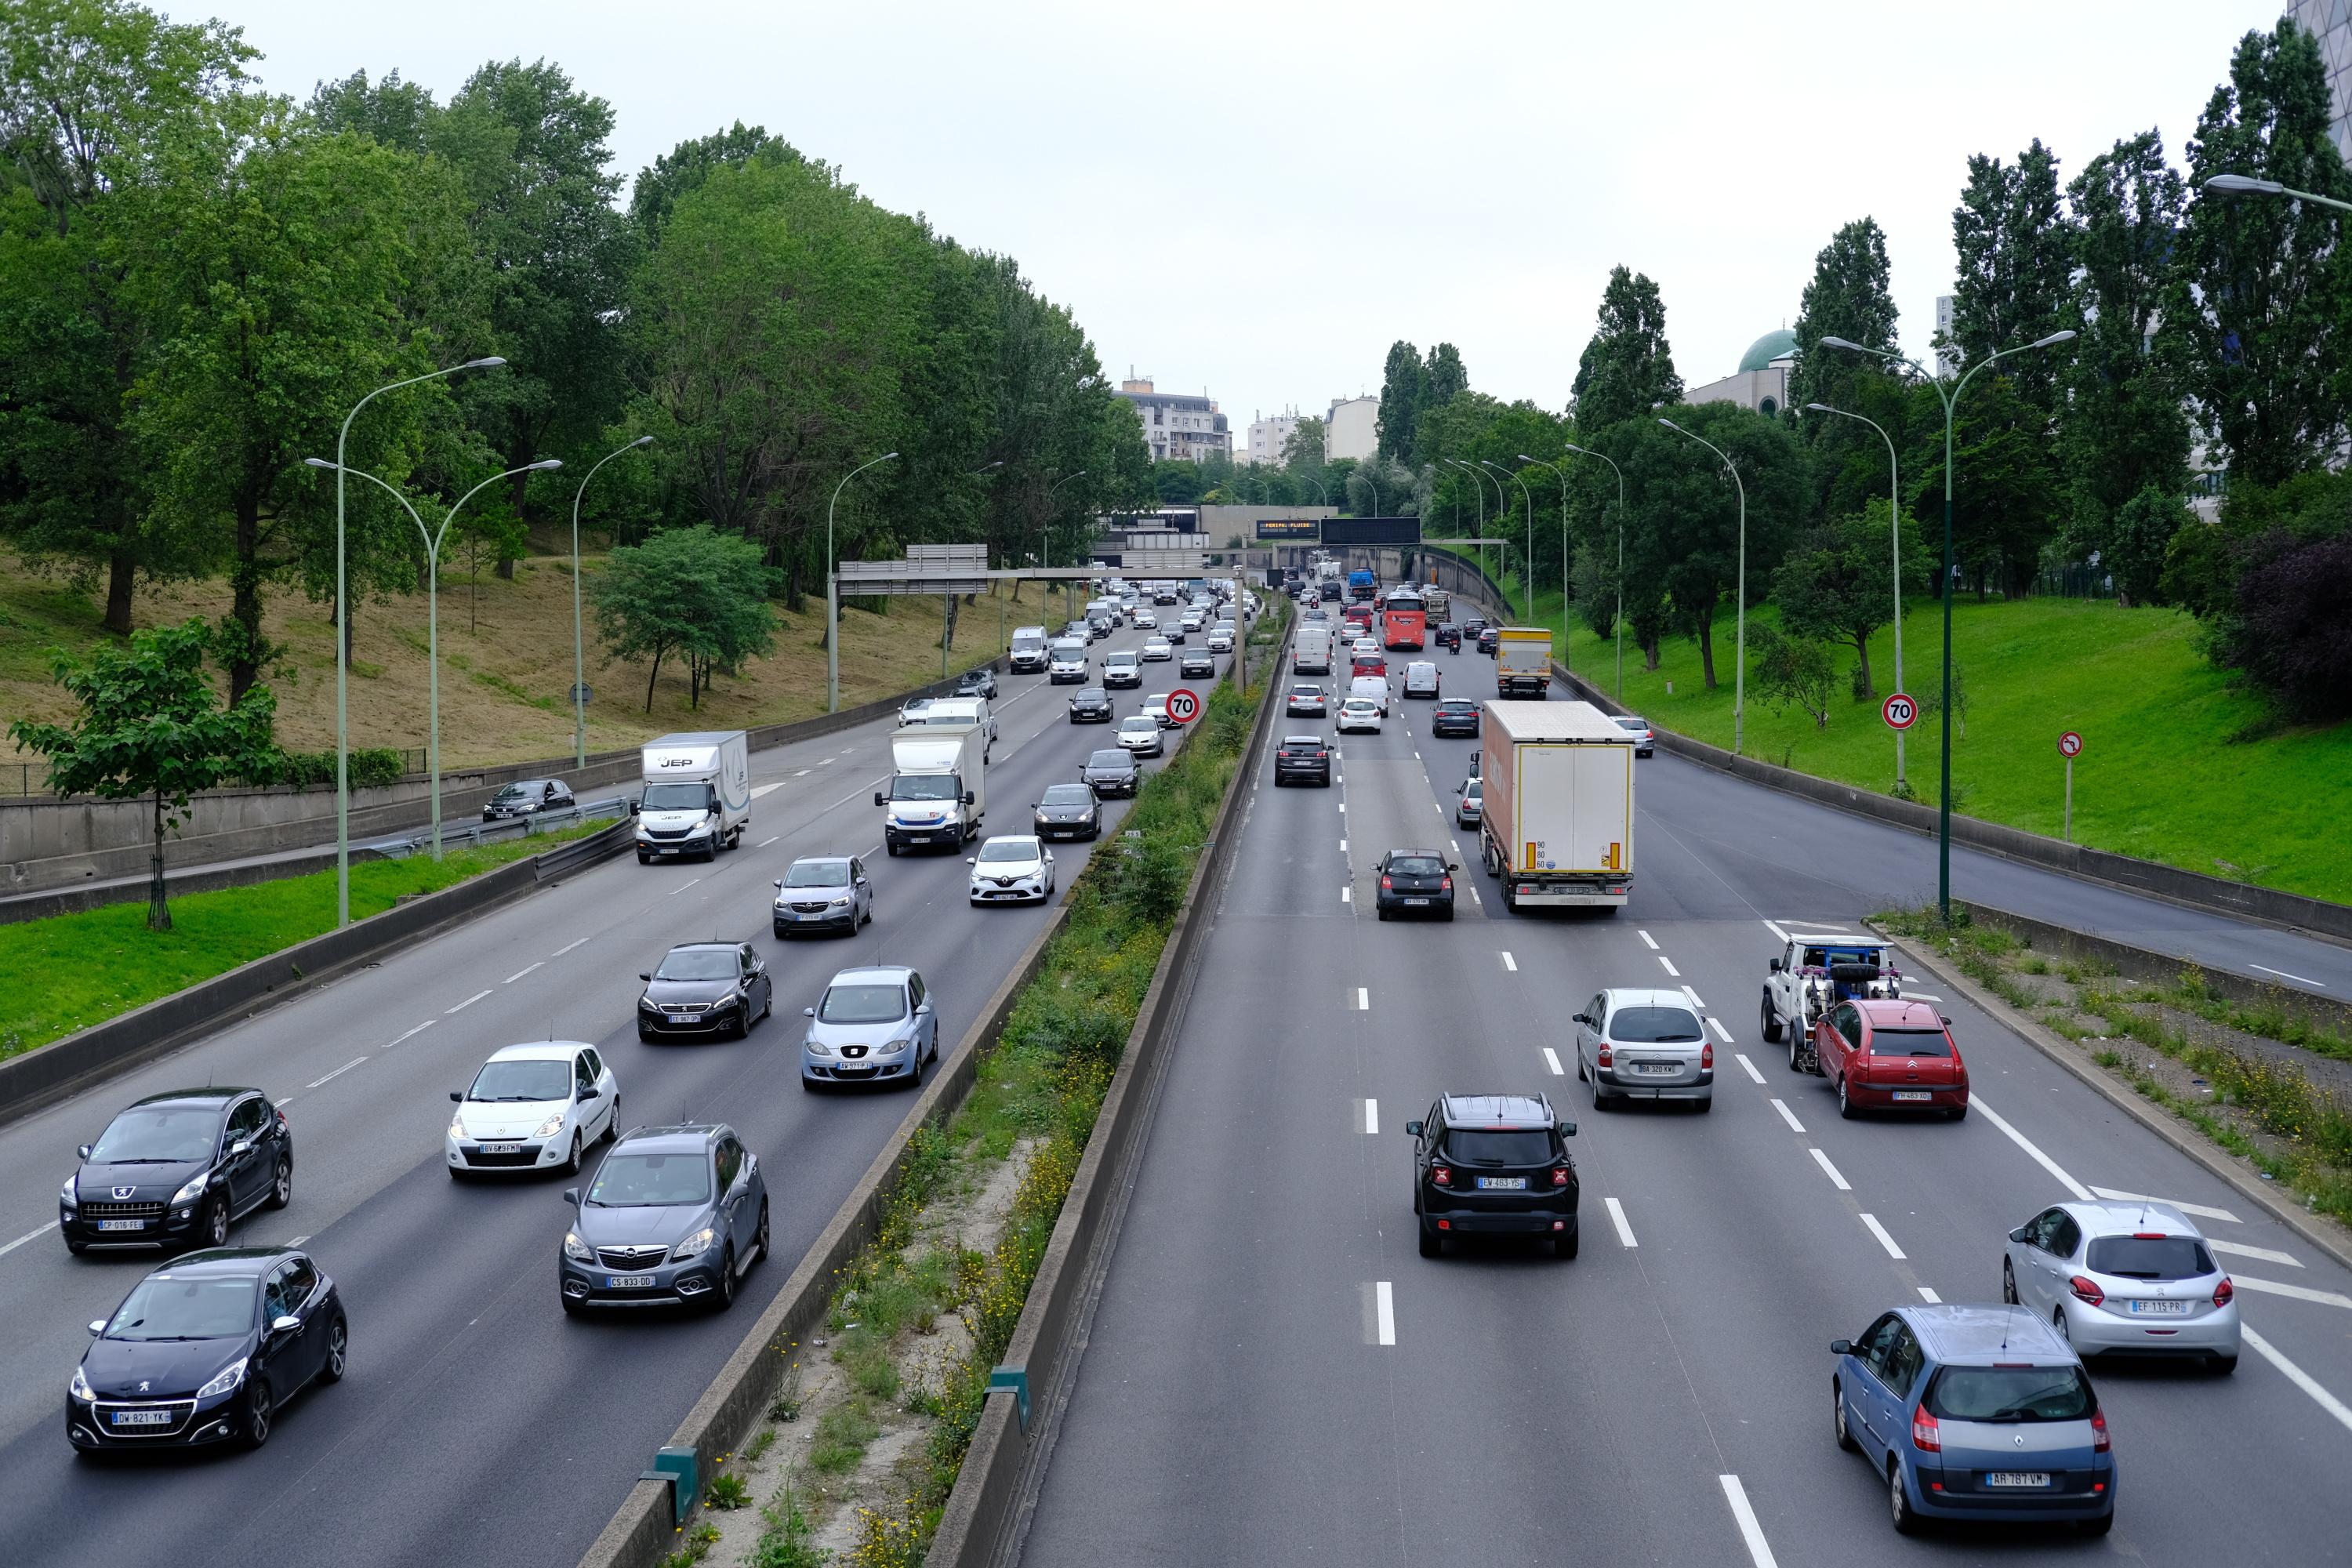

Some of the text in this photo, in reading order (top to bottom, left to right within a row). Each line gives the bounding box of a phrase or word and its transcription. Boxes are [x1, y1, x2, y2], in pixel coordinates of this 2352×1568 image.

[1174, 699, 1192, 713] 70
[1890, 704, 1910, 718] 70
[660, 759, 693, 768] JEP
[103, 1220, 138, 1229] CP-016-FE
[612, 1277, 651, 1286] CS-833-DD
[2138, 1301, 2181, 1312] EF-115-PR
[119, 1413, 164, 1423] DW-821-YK
